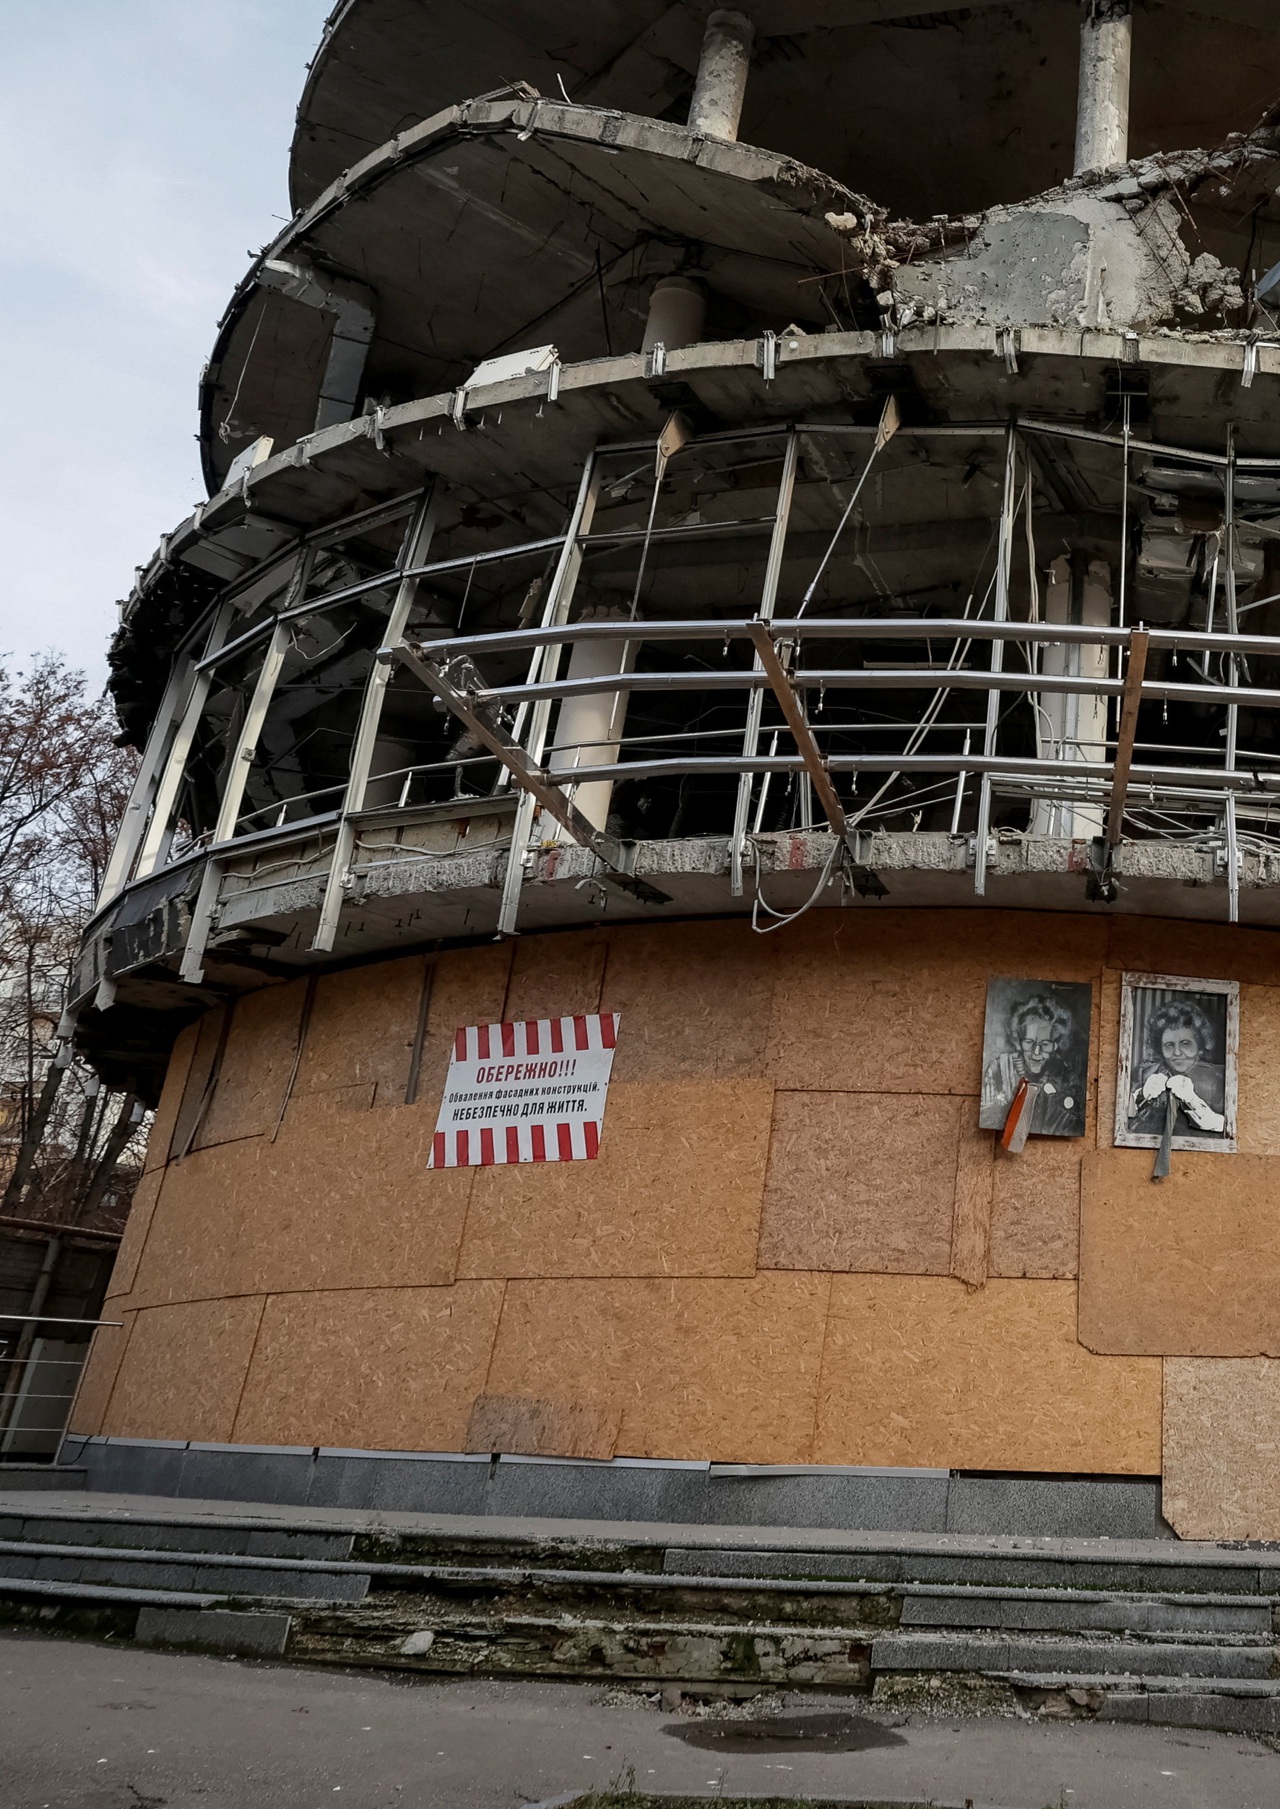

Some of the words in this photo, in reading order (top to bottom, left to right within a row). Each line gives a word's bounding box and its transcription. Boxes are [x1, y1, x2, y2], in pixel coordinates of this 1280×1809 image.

[476, 1059, 577, 1084] ОБЕРЕЖНО!!!
[448, 1090, 493, 1103] Обвалення
[495, 1087, 539, 1100] фасадних
[541, 1081, 600, 1095] конструкцій.
[452, 1103, 519, 1121] НЕБЕЗПЕЧНО
[520, 1102, 544, 1118] ДЛЯ
[546, 1099, 588, 1115] ЖИТТЯ.
